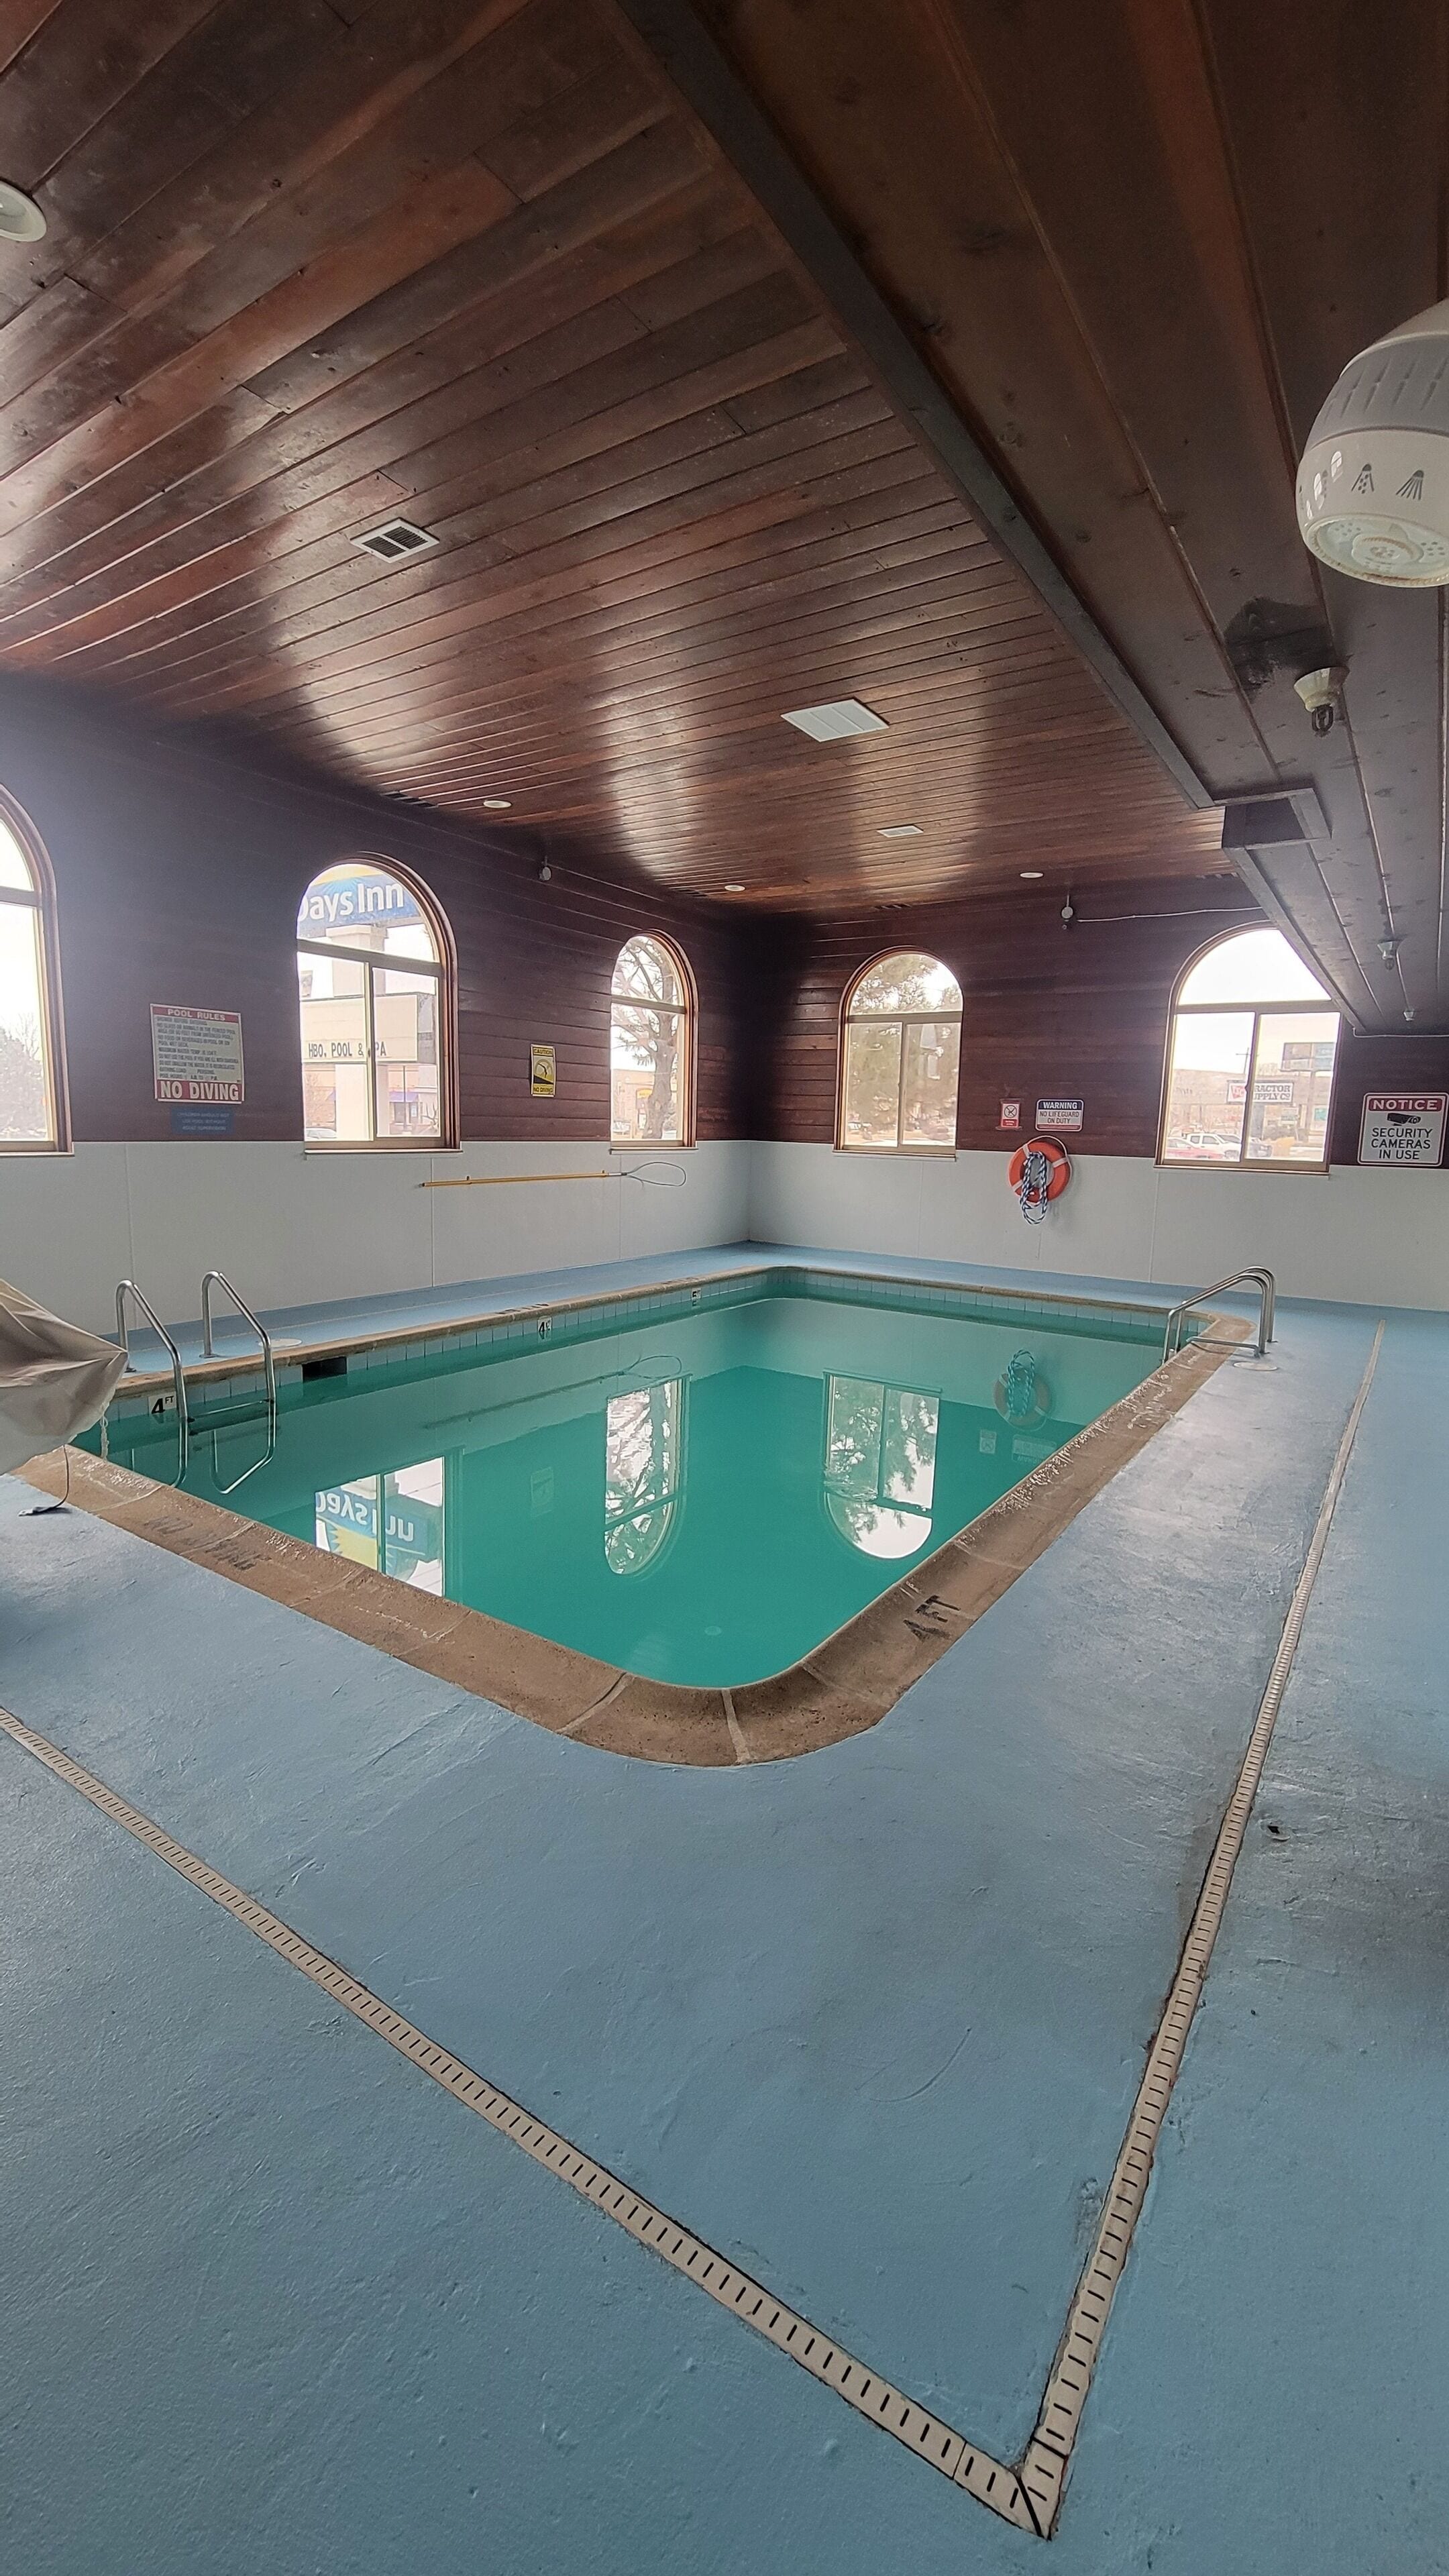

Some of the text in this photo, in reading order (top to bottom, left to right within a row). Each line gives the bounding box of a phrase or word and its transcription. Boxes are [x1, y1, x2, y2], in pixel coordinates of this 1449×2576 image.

[358, 883, 405, 914] Inn
[168, 1008, 226, 1021] POOL RULES
[331, 1042, 352, 1057] POOL
[358, 1042, 365, 1057] &
[160, 1081, 239, 1101] NO DIVING
[1254, 1085, 1291, 1093] RACTOR
[1043, 1102, 1078, 1110] WARNING
[1373, 1099, 1438, 1110] NOTICE
[1371, 1128, 1433, 1138] SECURITY
[1371, 1138, 1432, 1149] CAMERAS
[1379, 1149, 1420, 1160] IN USE
[152, 1395, 174, 1415] 4 FT
